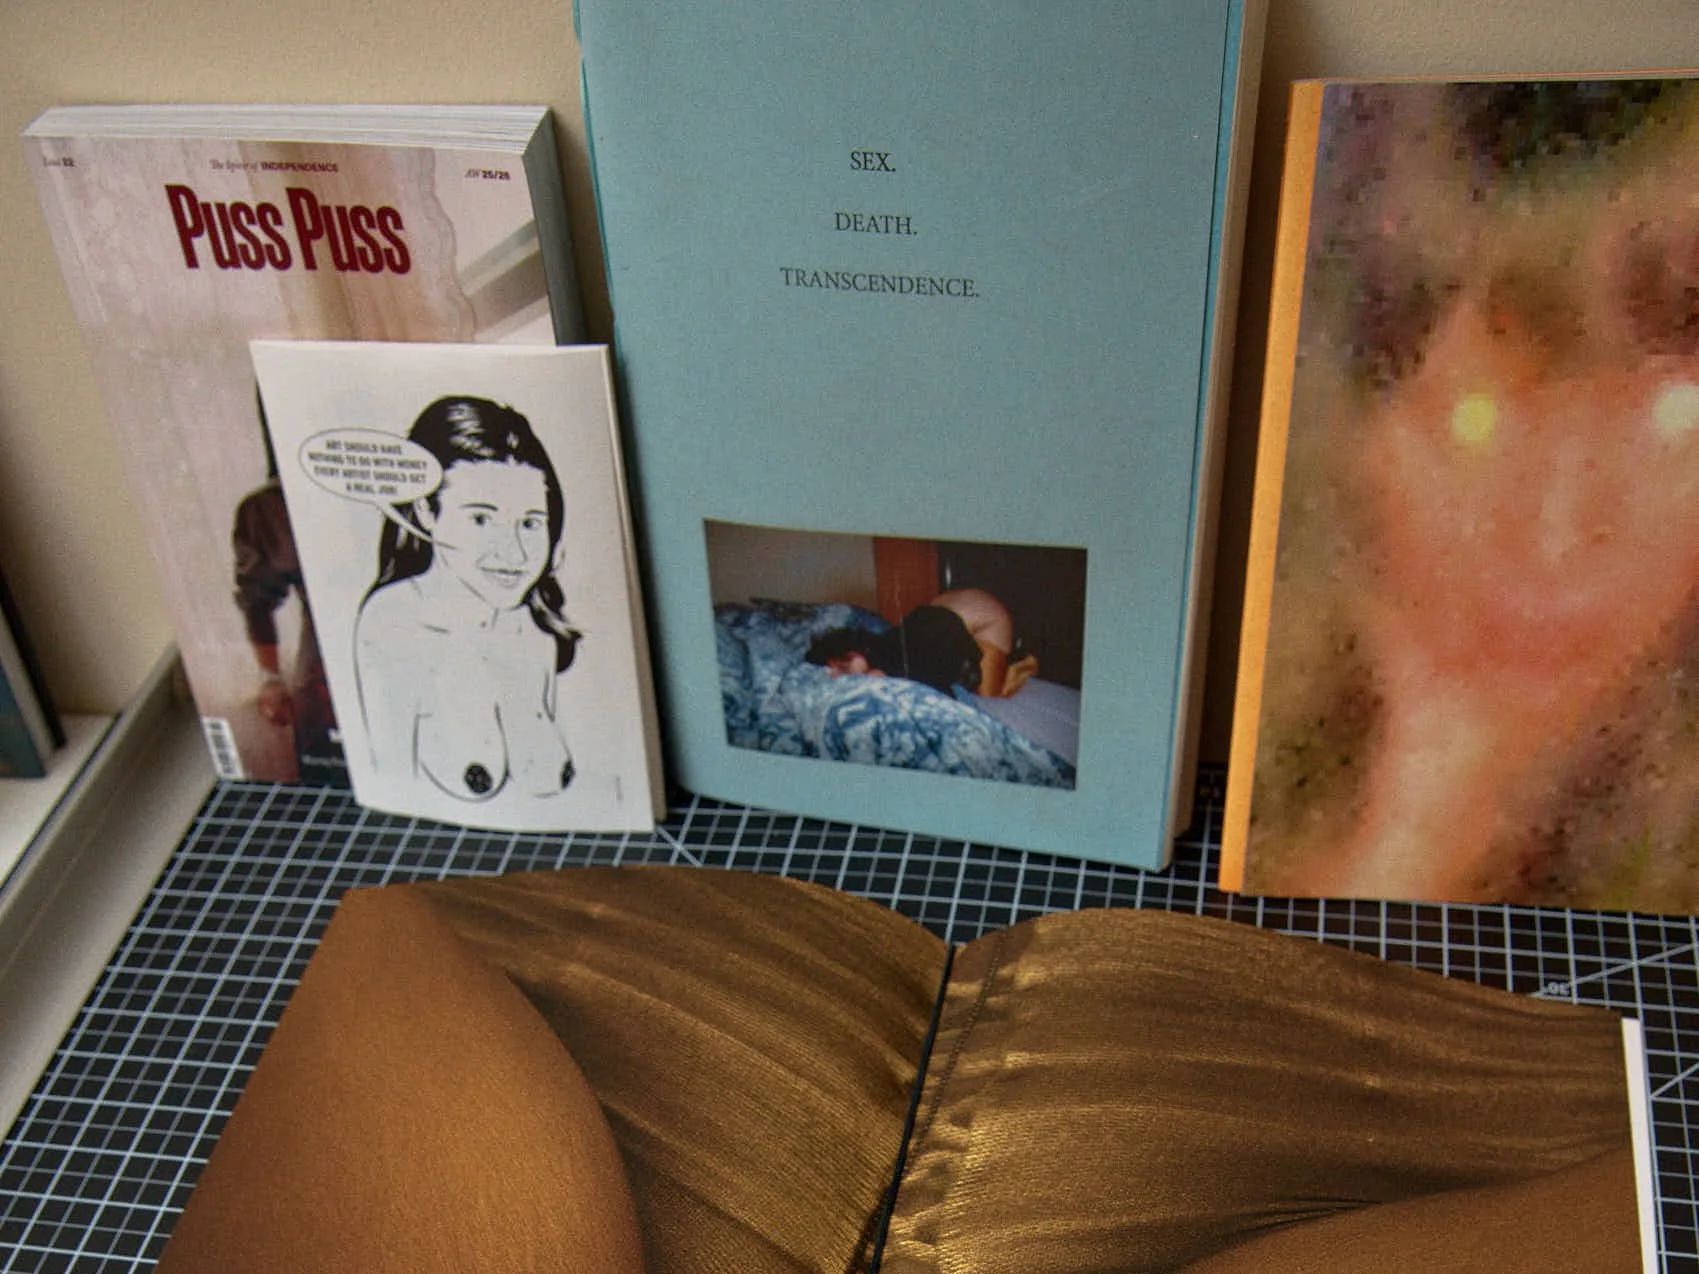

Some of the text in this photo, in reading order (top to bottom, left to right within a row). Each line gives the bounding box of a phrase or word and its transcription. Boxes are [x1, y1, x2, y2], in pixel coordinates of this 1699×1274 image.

[261, 161, 339, 173] INDEPENDENCE
[851, 151, 897, 173] SEX.
[166, 185, 411, 275] Puss Puss
[835, 212, 918, 236] DEATH.
[780, 267, 980, 298] TRANSCENDENCE.
